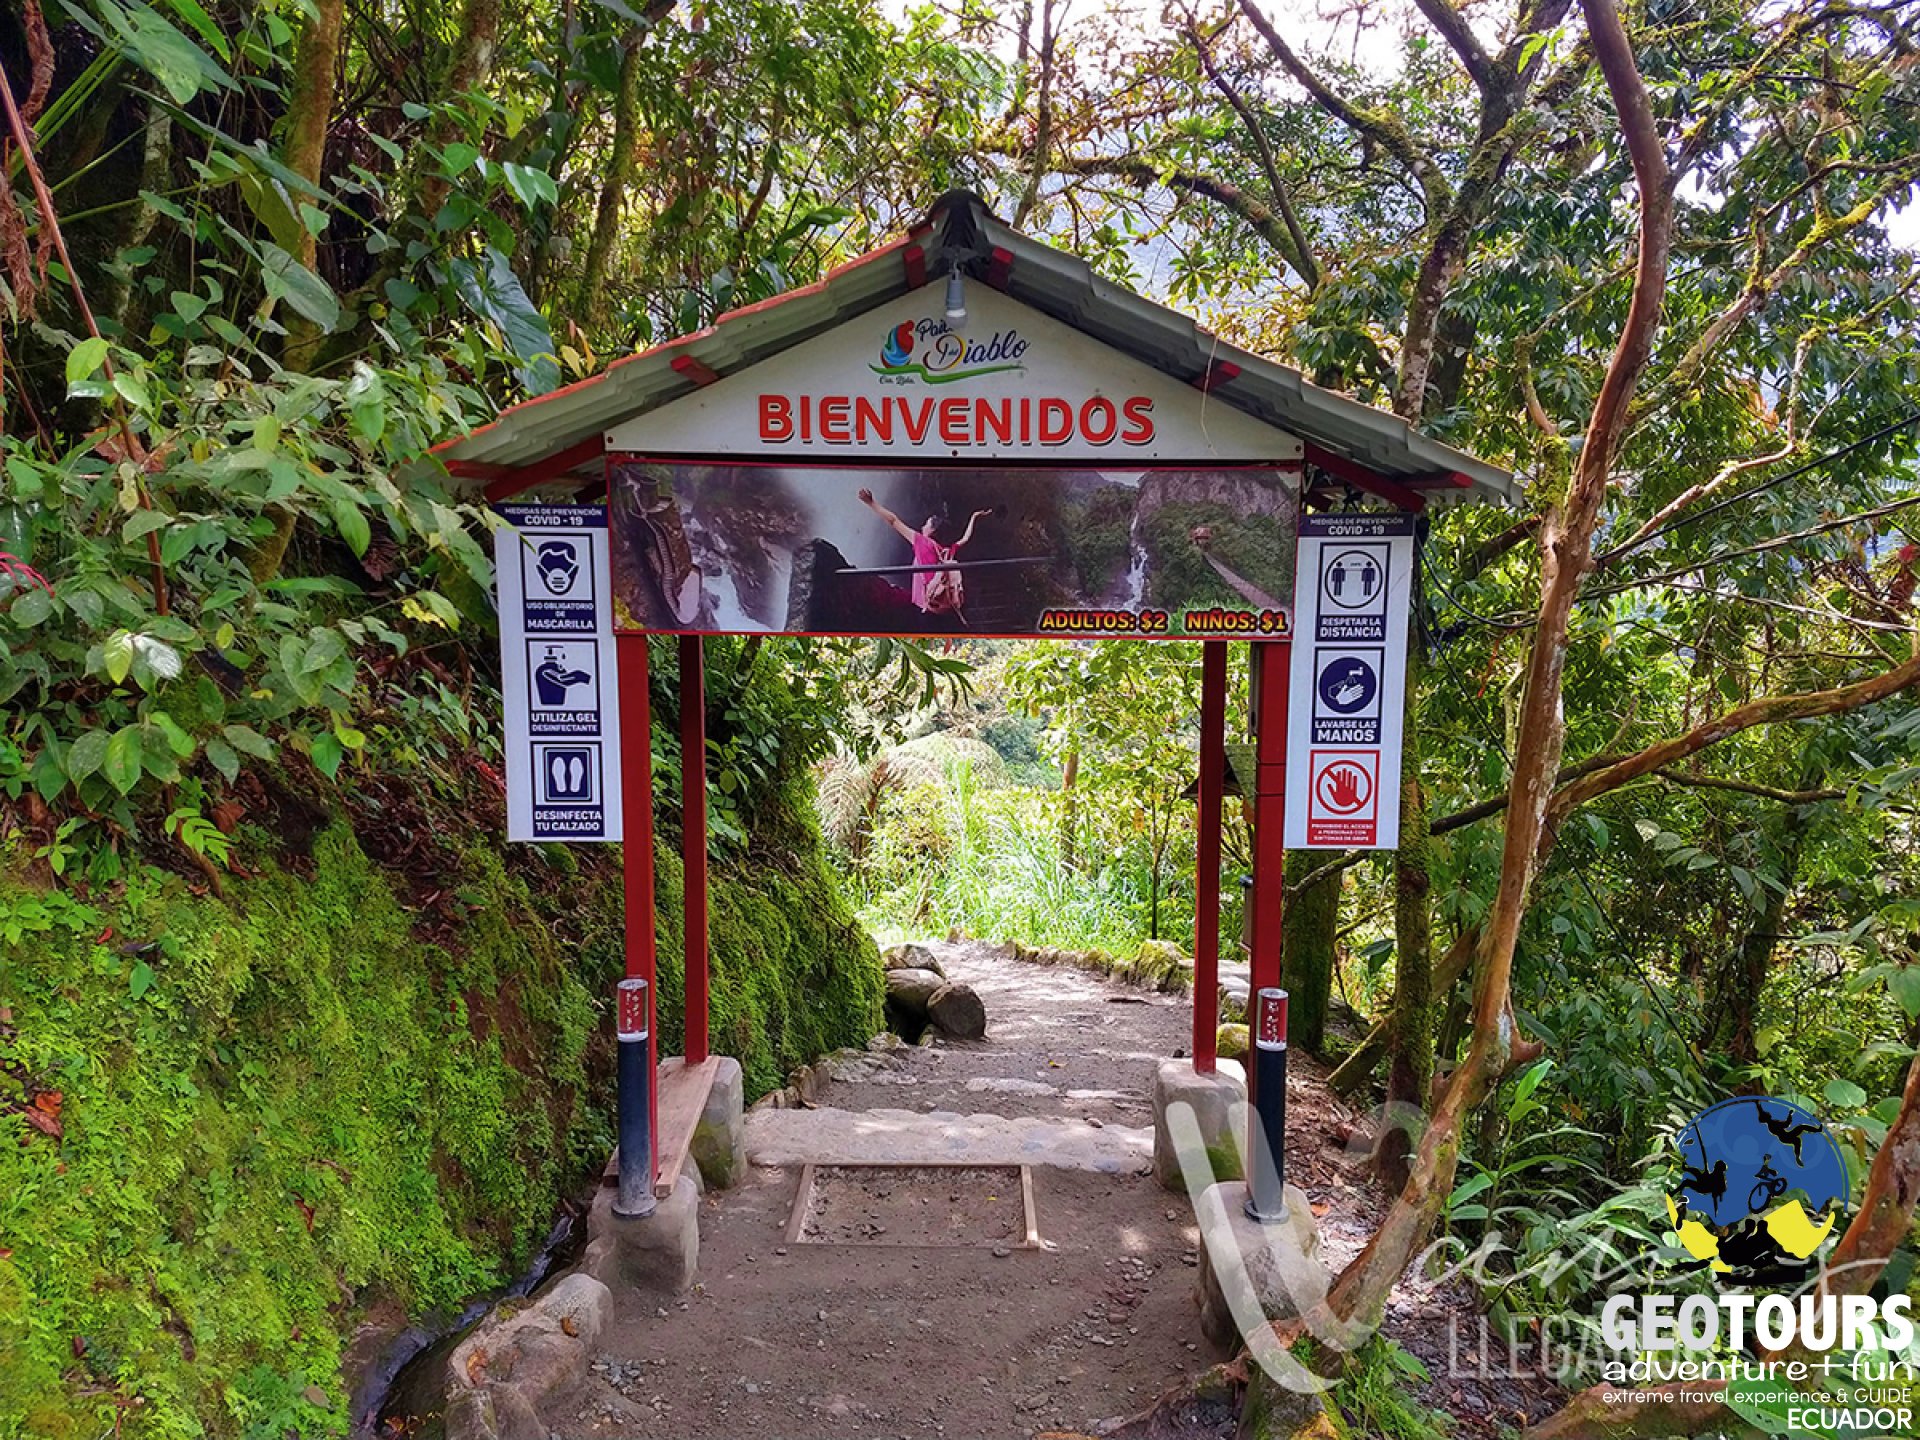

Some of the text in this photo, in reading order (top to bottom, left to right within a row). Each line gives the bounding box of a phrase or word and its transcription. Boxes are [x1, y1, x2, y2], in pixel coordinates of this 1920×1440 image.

[922, 329, 1032, 372] Diablo
[758, 394, 1158, 448] BIENVENIDOS
[504, 507, 540, 515] MEDIDAS
[552, 507, 603, 516] PREVENCIÓN
[524, 515, 561, 526] COVID
[569, 516, 583, 526] 19
[1310, 516, 1404, 525] MEDIDAS DE PREVENCIÓN
[1327, 525, 1363, 535] COVID
[1371, 525, 1385, 535] 19
[526, 602, 594, 610] USO OBLIGATORIO
[555, 610, 566, 618] DE
[527, 619, 595, 630] MASCARILLA
[1041, 608, 1287, 633] ADULTOS: $2 NIÑOS: $1
[1322, 617, 1381, 627] RESPETAR LA
[1320, 626, 1382, 638] DISTANCIA
[531, 712, 598, 723] UTILIZA GEL
[532, 724, 598, 732] DESINFECTANTE
[1314, 720, 1377, 729] LAVARSE LAS
[1317, 729, 1375, 742] MANOS
[535, 810, 602, 820] DESINFECTA
[535, 821, 600, 831] TU CALZADO
